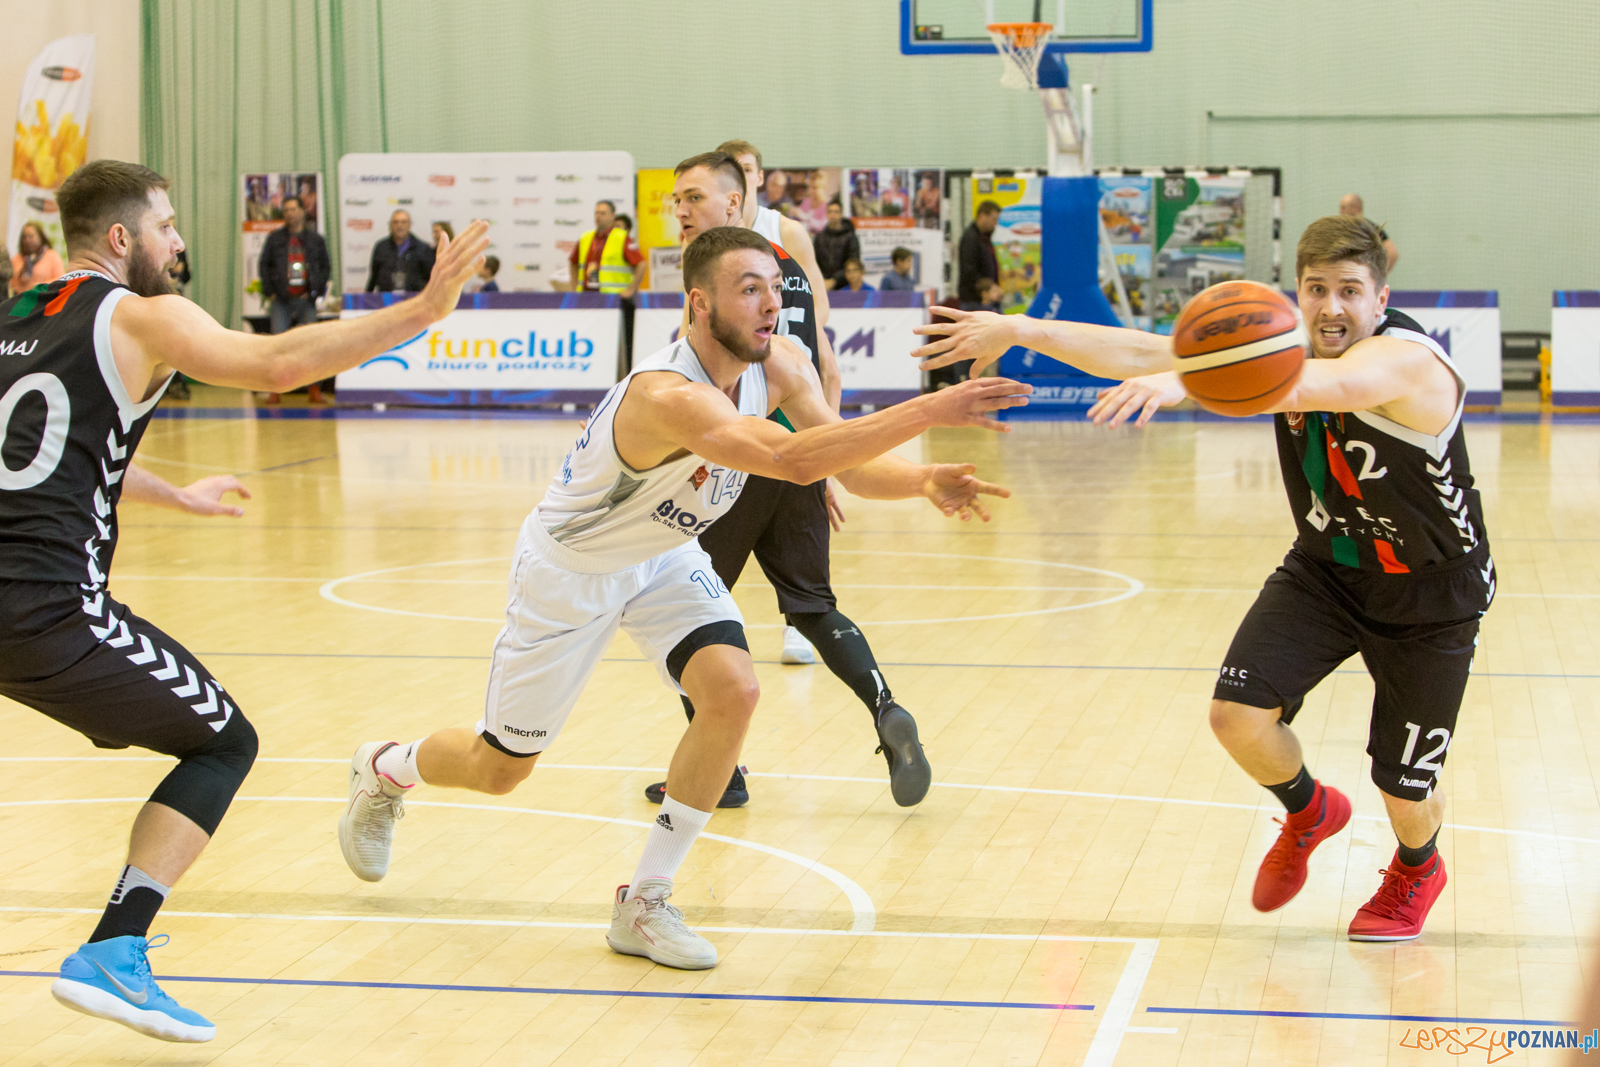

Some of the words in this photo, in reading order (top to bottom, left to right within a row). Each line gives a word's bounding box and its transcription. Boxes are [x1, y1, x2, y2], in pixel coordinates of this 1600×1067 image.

[426, 331, 594, 358] funclub
[427, 360, 488, 370] biuro
[497, 359, 592, 372] podróży
[1344, 440, 1388, 481] 2
[710, 468, 743, 505] 14
[1221, 666, 1248, 680] PEC
[504, 724, 547, 738] macron
[1400, 721, 1450, 771] 12
